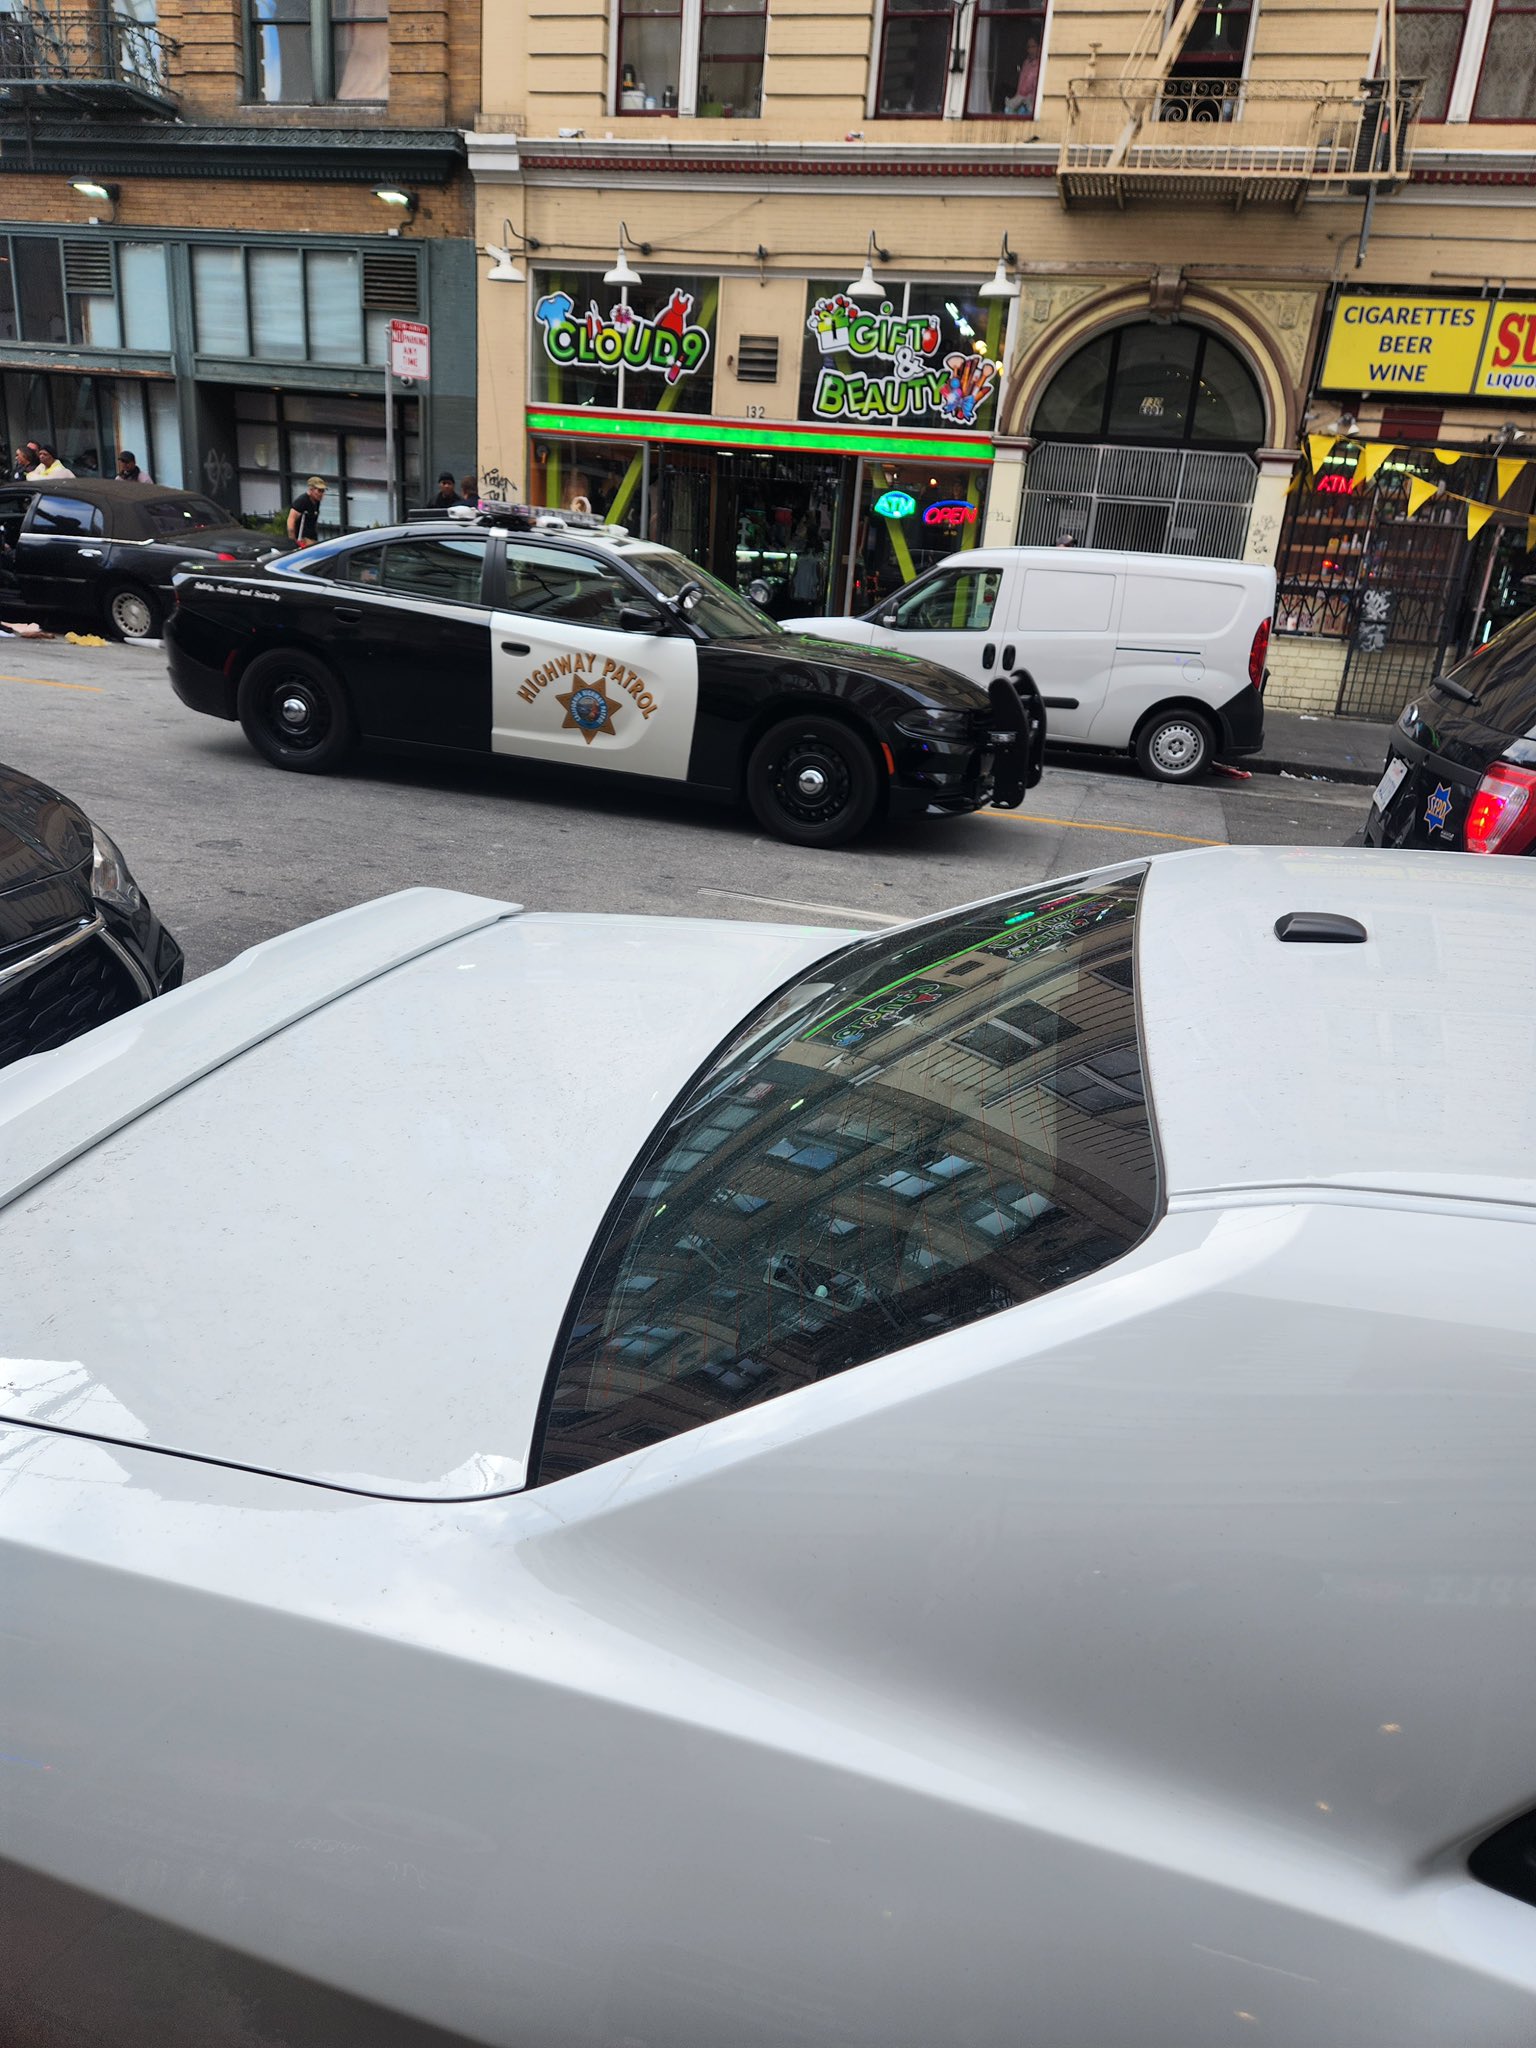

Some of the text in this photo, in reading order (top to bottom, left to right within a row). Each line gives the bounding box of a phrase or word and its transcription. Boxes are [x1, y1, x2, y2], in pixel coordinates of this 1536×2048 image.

[1344, 306, 1475, 326] CIGARETTES
[849, 306, 928, 353] GIFT
[1378, 336, 1432, 354] BEER
[895, 347, 926, 379] &
[1369, 364, 1428, 382] WINE
[1487, 373, 1536, 389] LIQUO
[818, 371, 950, 415] BEAUTY
[746, 405, 765, 419] 132
[1317, 474, 1353, 495] ATM
[880, 496, 915, 516] ATM
[925, 506, 978, 525] OPEN
[516, 652, 658, 720] HIGHWAY PATROL
